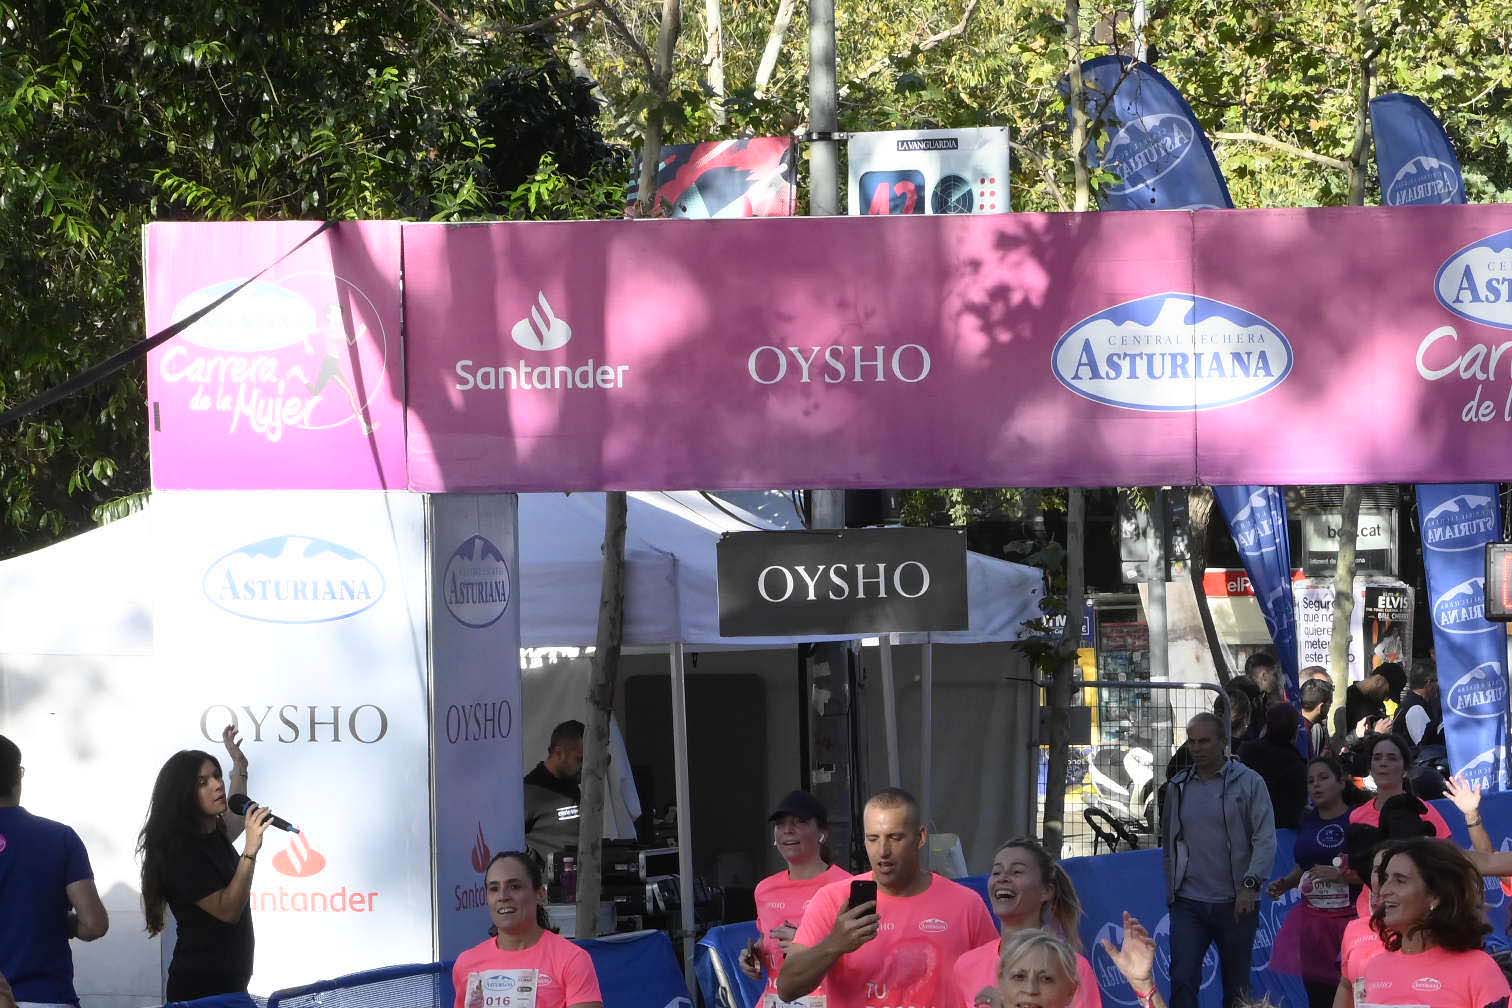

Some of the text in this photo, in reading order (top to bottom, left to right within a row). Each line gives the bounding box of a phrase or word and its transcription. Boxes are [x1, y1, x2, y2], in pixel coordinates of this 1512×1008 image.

[1108, 332, 1265, 345] CENTRAL LECHERA
[162, 345, 279, 383] Carrera
[455, 358, 630, 391] Santander
[748, 343, 931, 384] OYSHO
[1071, 336, 1275, 382] ASTURIANA
[229, 380, 322, 442] Mujer
[1461, 384, 1496, 423] de
[218, 568, 372, 601] ASTURIANA
[448, 573, 507, 607] ASTURIANA
[757, 560, 931, 603] OYSHO
[1304, 614, 1319, 623] que
[1378, 596, 1408, 608] ELVIS
[1305, 653, 1323, 662] este
[200, 704, 389, 744] OYSHO
[446, 700, 511, 744] OYSHO
[486, 996, 510, 1006] 016
[866, 983, 886, 999] TU
